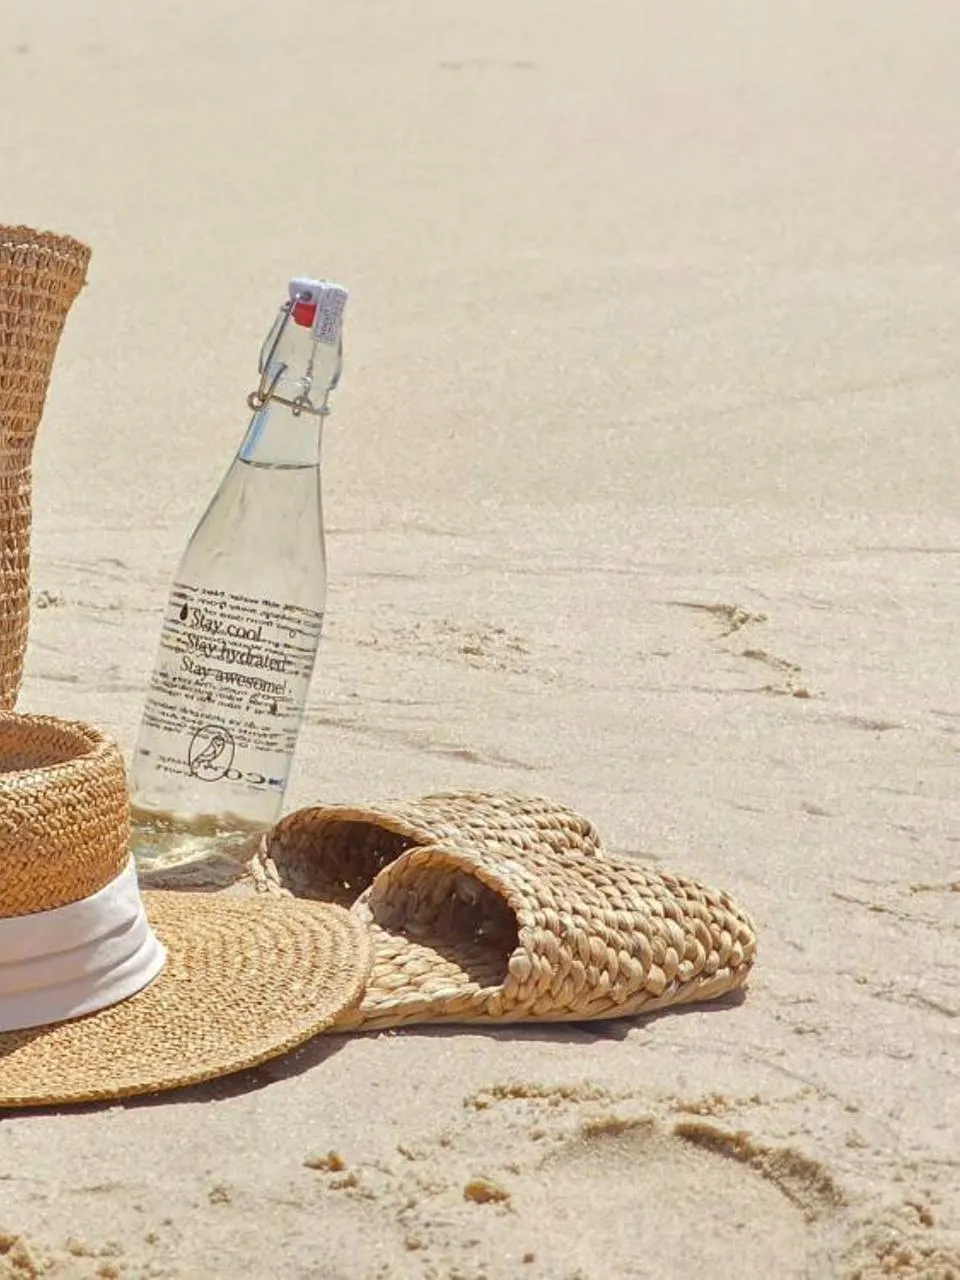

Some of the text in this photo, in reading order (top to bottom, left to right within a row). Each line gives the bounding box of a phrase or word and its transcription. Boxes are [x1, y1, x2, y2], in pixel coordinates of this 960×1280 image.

[192, 609, 262, 642] Stay cool
[180, 655, 209, 680] Stay
[187, 633, 286, 673] Stay hydrated
